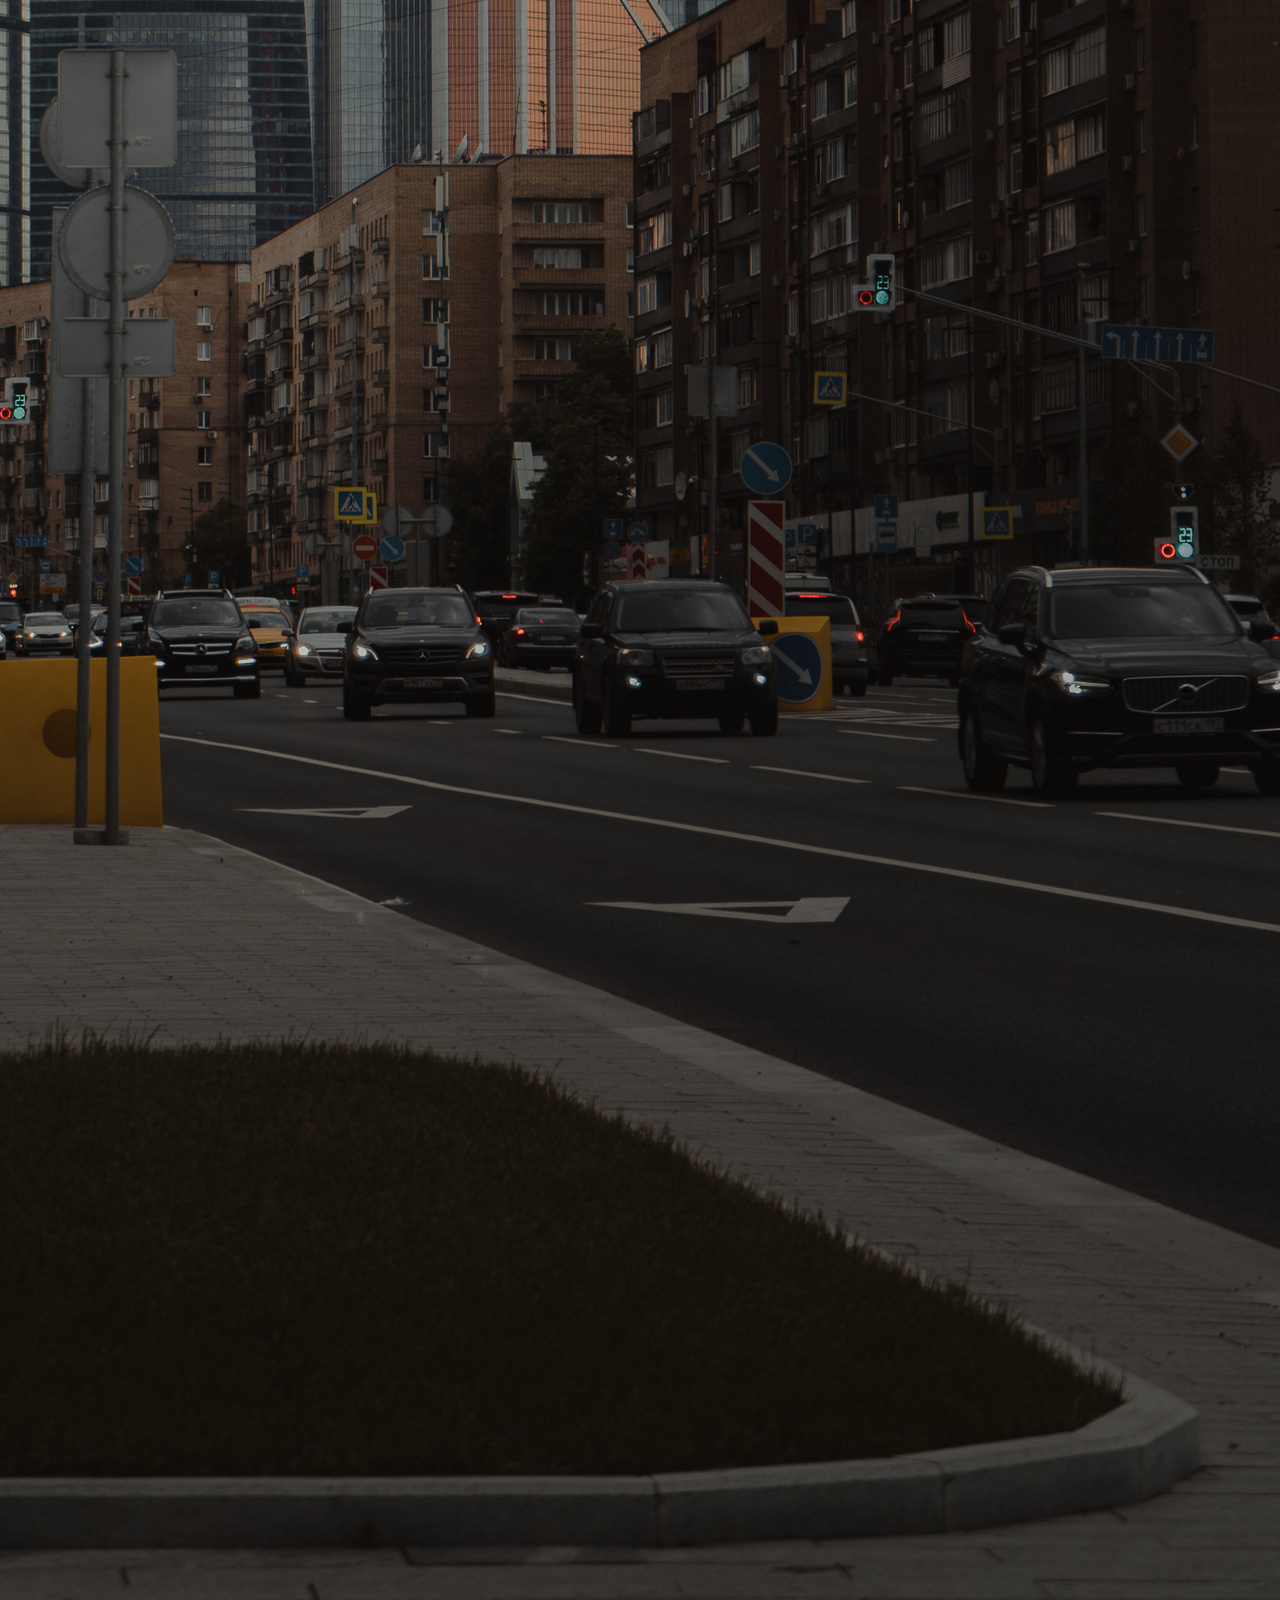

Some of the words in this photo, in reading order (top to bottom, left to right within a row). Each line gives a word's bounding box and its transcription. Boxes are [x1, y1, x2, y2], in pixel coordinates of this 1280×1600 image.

[877, 275, 890, 290] 23
[14, 394, 26, 407] 23
[1178, 527, 1193, 543] 23
[1201, 557, 1234, 568] СТОП
